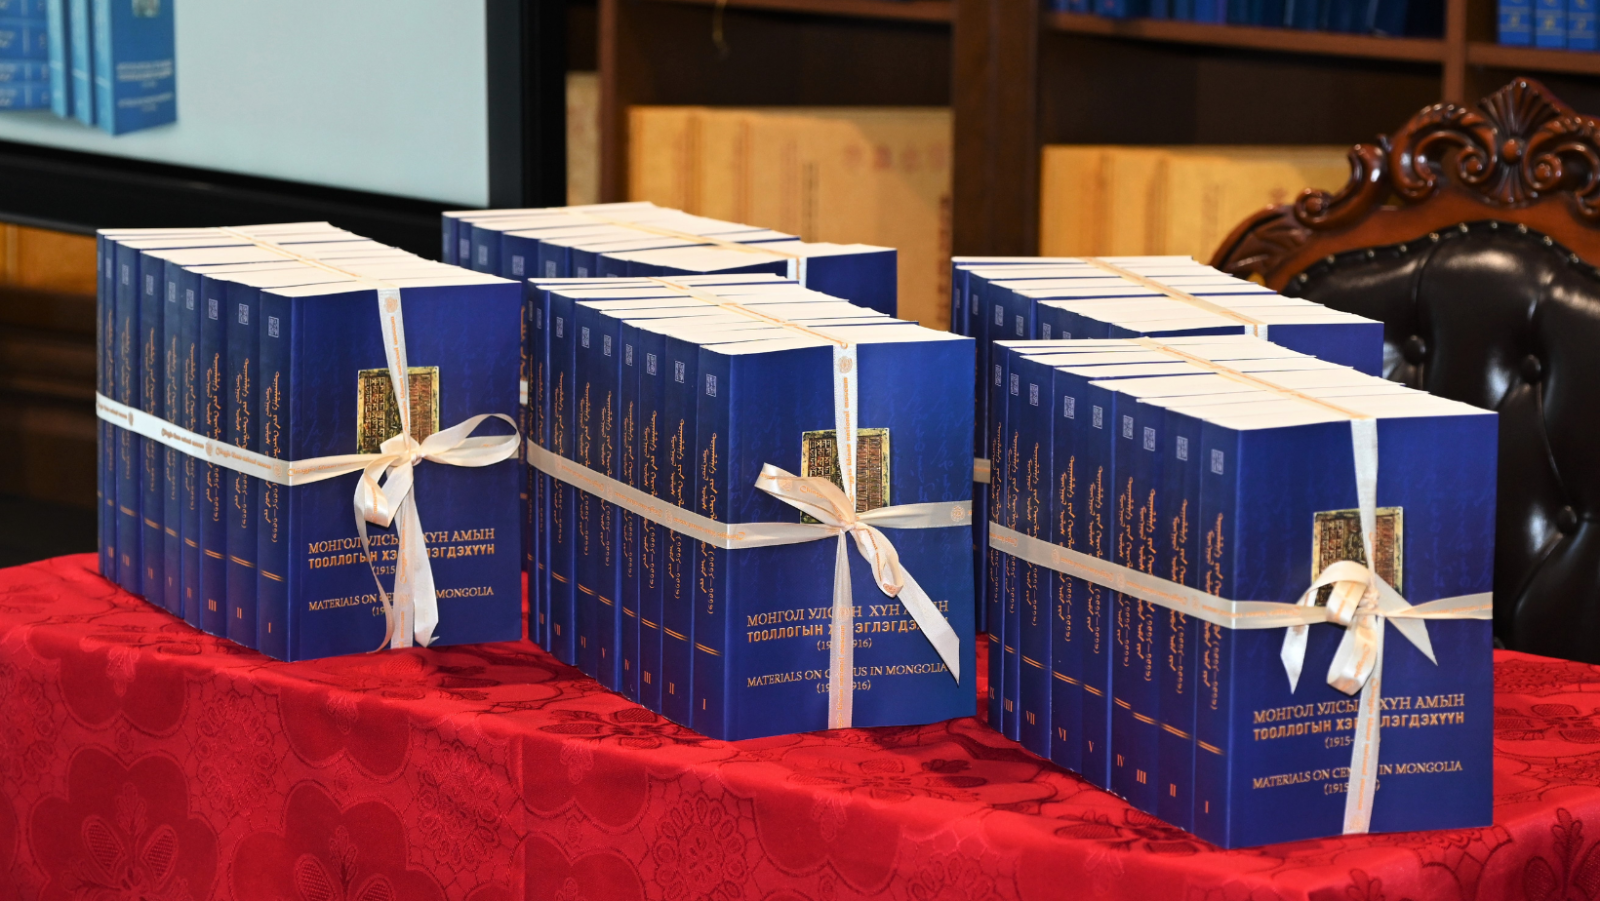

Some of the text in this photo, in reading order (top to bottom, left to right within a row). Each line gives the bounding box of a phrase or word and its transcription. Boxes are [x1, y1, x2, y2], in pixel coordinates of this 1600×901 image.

[308, 538, 362, 554] МОНГОЛ
[452, 528, 495, 542] АМЫН
[436, 586, 494, 599] MONGOLIA
[308, 595, 360, 611] MATERIALS
[362, 593, 377, 604] ON
[747, 608, 805, 627] МОНГОЛ
[869, 604, 900, 617] ХҮН
[747, 624, 823, 643] ТООЛЛОГЫН
[747, 670, 802, 688] MATERIALS
[804, 669, 822, 680] ON
[870, 666, 883, 677] IN
[885, 662, 948, 676] MONGOLIA
[1253, 694, 1465, 724] МОНГОЛ УЛСЫ ХҮН АМЫН
[1026, 710, 1035, 726] VII
[1058, 727, 1067, 742] VI
[1253, 720, 1331, 741] ТООЛЛОГЫН
[1088, 741, 1094, 753] V
[1117, 754, 1125, 767] IV
[1136, 769, 1147, 784] III
[1253, 771, 1311, 789] MATERIALS
[1313, 769, 1330, 781] ON
[1379, 764, 1393, 776] IN
[1395, 760, 1463, 774] MONGOLIA
[1169, 783, 1177, 797] II
[1204, 801, 1209, 813] I
